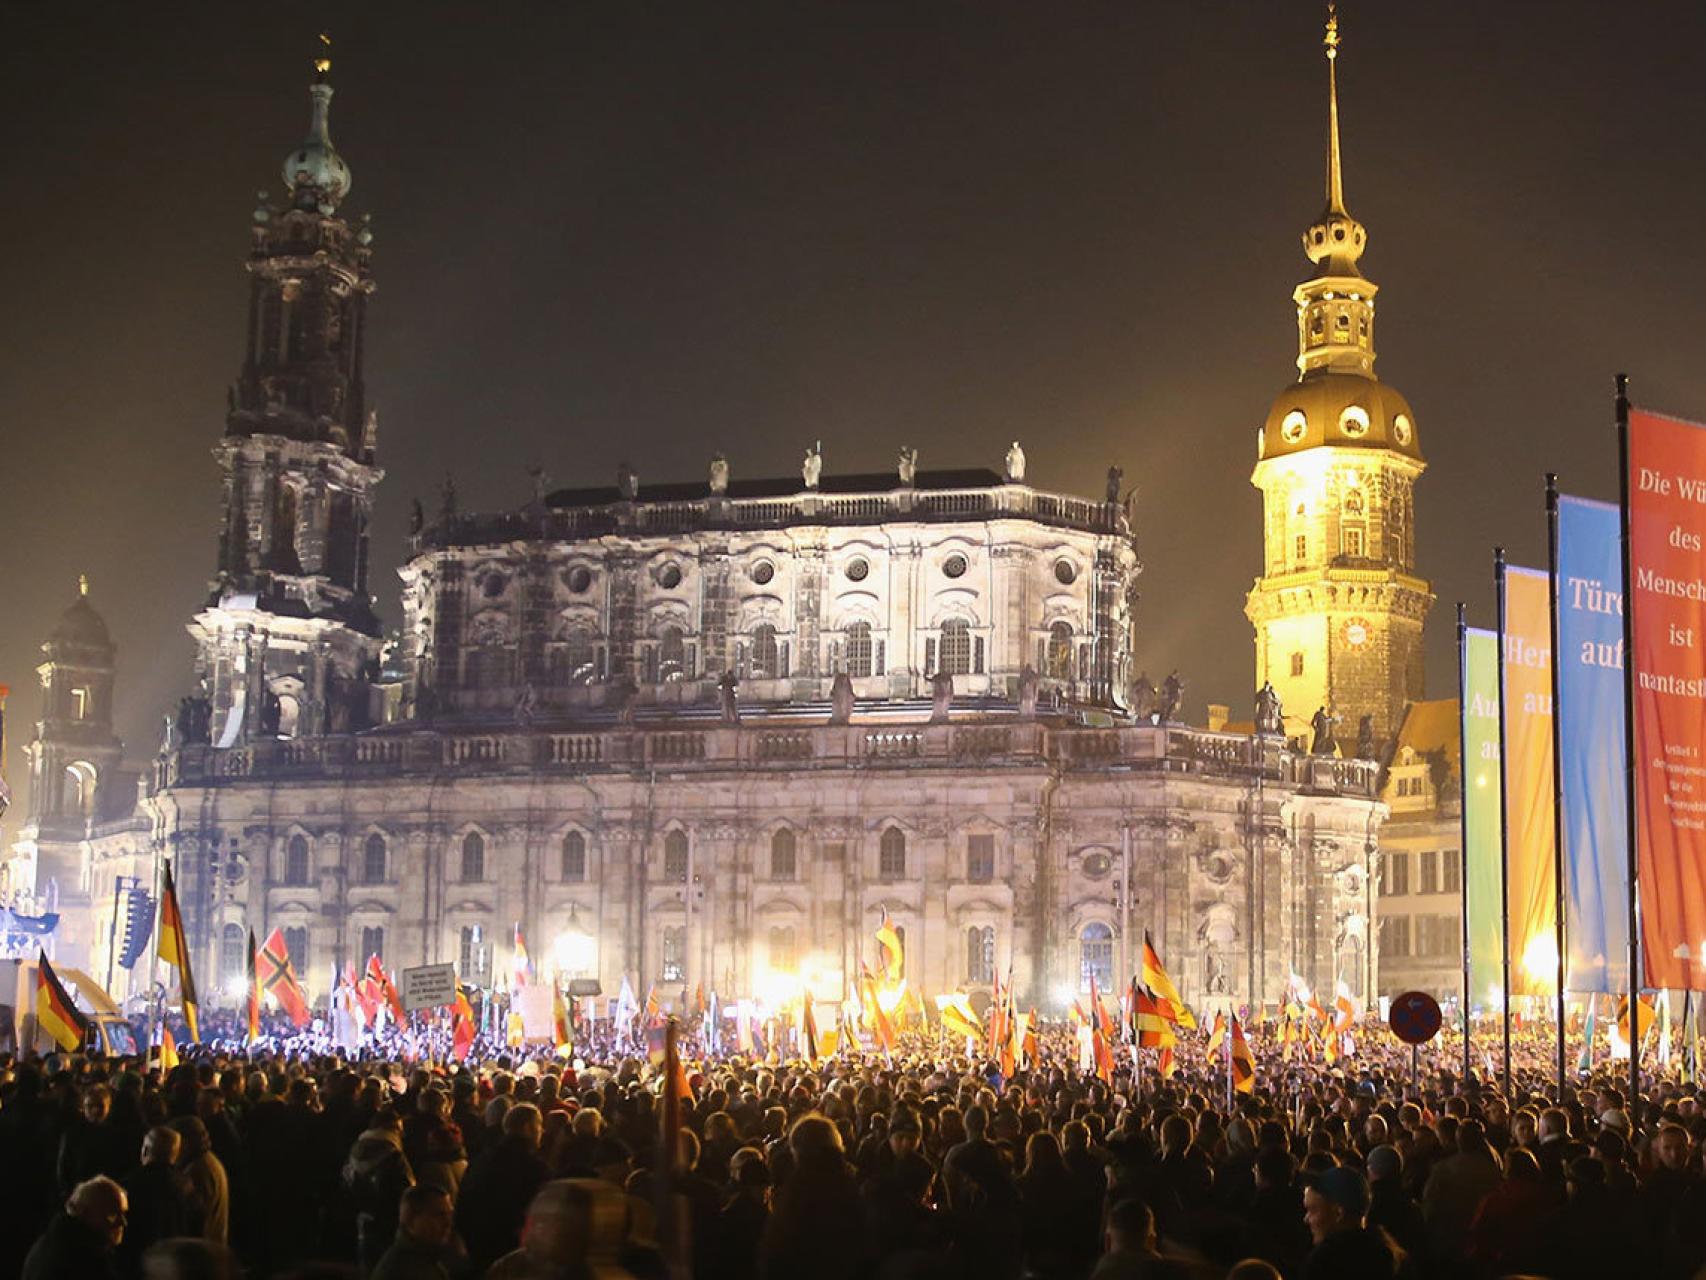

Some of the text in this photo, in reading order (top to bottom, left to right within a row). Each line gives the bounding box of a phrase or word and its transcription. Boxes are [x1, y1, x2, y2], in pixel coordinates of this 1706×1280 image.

[1640, 468, 1671, 496] Die
[1669, 525, 1701, 552] des
[1668, 622, 1694, 648] ist
